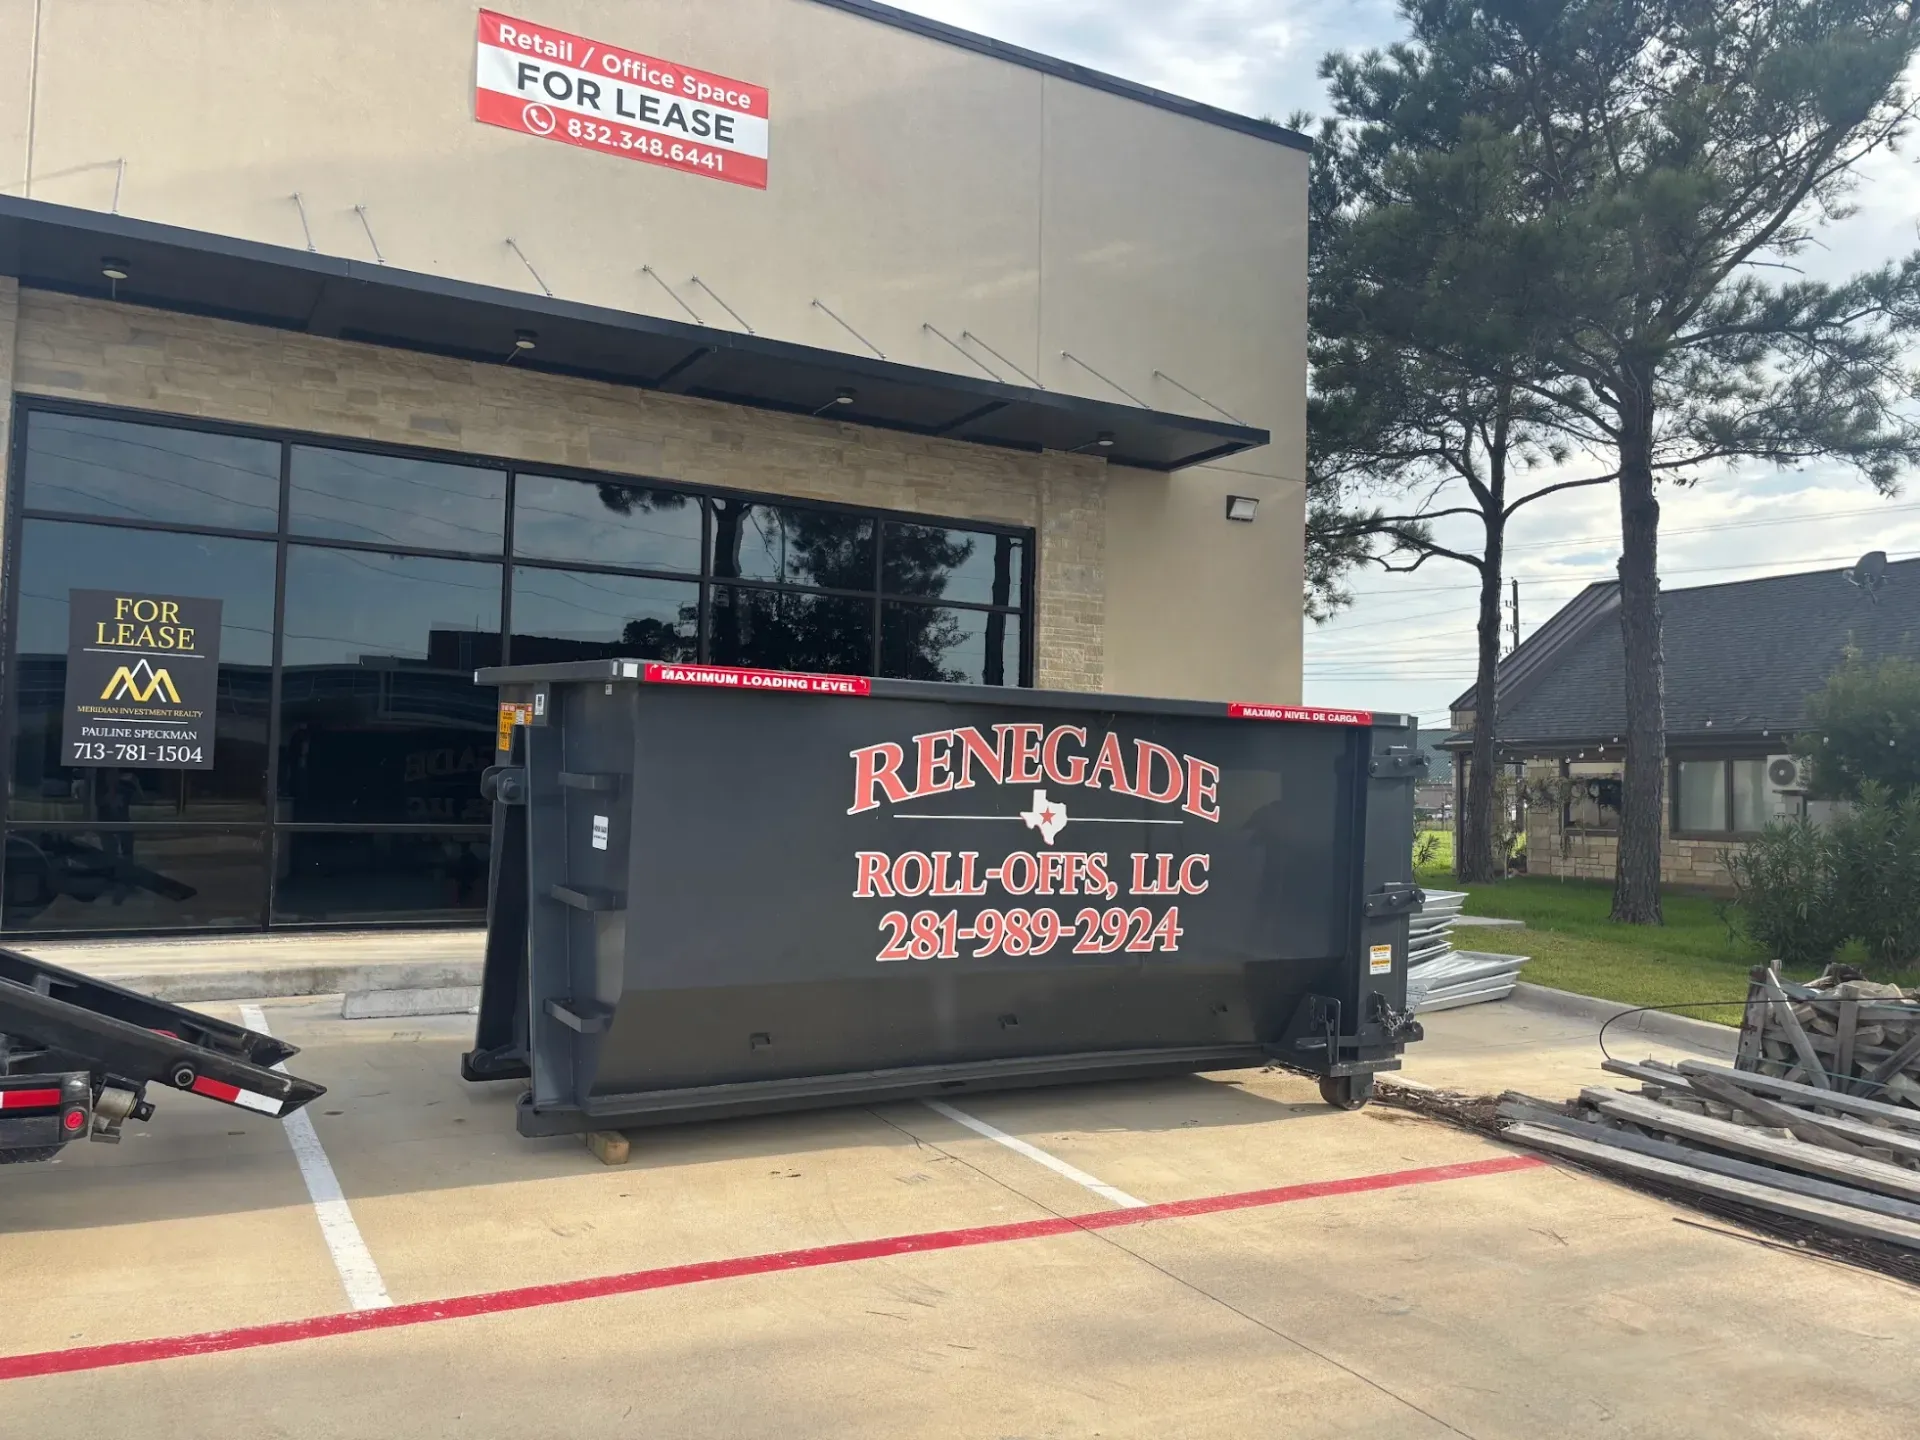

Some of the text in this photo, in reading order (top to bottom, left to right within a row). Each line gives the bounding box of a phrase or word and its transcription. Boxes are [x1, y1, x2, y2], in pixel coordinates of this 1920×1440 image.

[499, 23, 751, 109] Retail / Office Space
[517, 62, 735, 144] FOR LEASE
[567, 118, 724, 172] 832.348.6441
[114, 598, 180, 624] FOR
[95, 622, 194, 650] LEASE
[661, 670, 856, 692] MAXIMUM LOADING LEVEL
[77, 705, 203, 718] MERIDIAN INVESTMENT REALTY
[1243, 707, 1358, 723] MAXIMO NIVEL DE CARGA
[81, 727, 197, 740] PAULINE SPECKMAN
[73, 742, 203, 762] 713-781-1504
[847, 723, 1220, 823] RENEGADE
[853, 851, 1210, 900] ROLL-OFFS, LLC
[876, 906, 1184, 962] 281-989-2924
